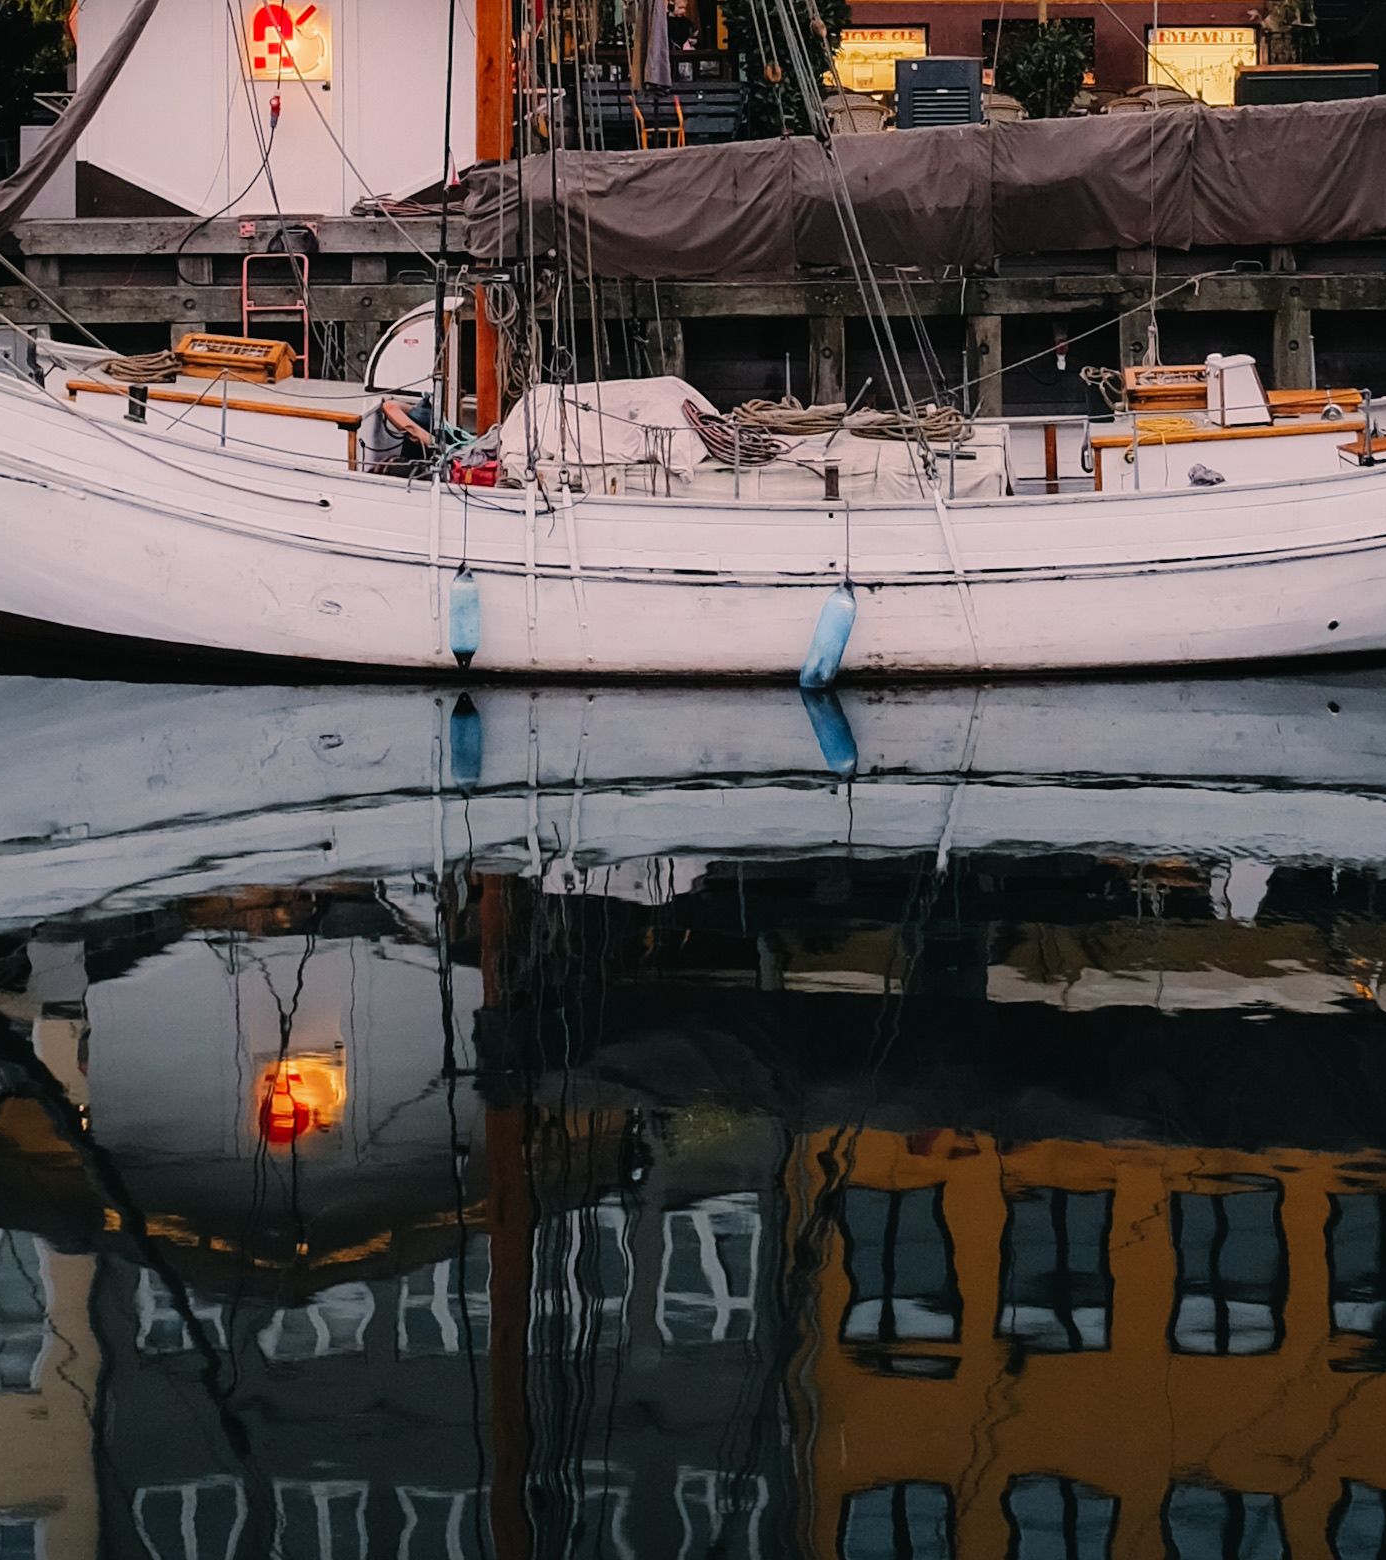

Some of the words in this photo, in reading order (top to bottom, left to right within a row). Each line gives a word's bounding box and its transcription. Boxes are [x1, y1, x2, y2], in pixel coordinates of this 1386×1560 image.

[891, 31, 917, 41] OLE
[1159, 31, 1224, 42] NYHAVN
[1230, 32, 1244, 43] 17
